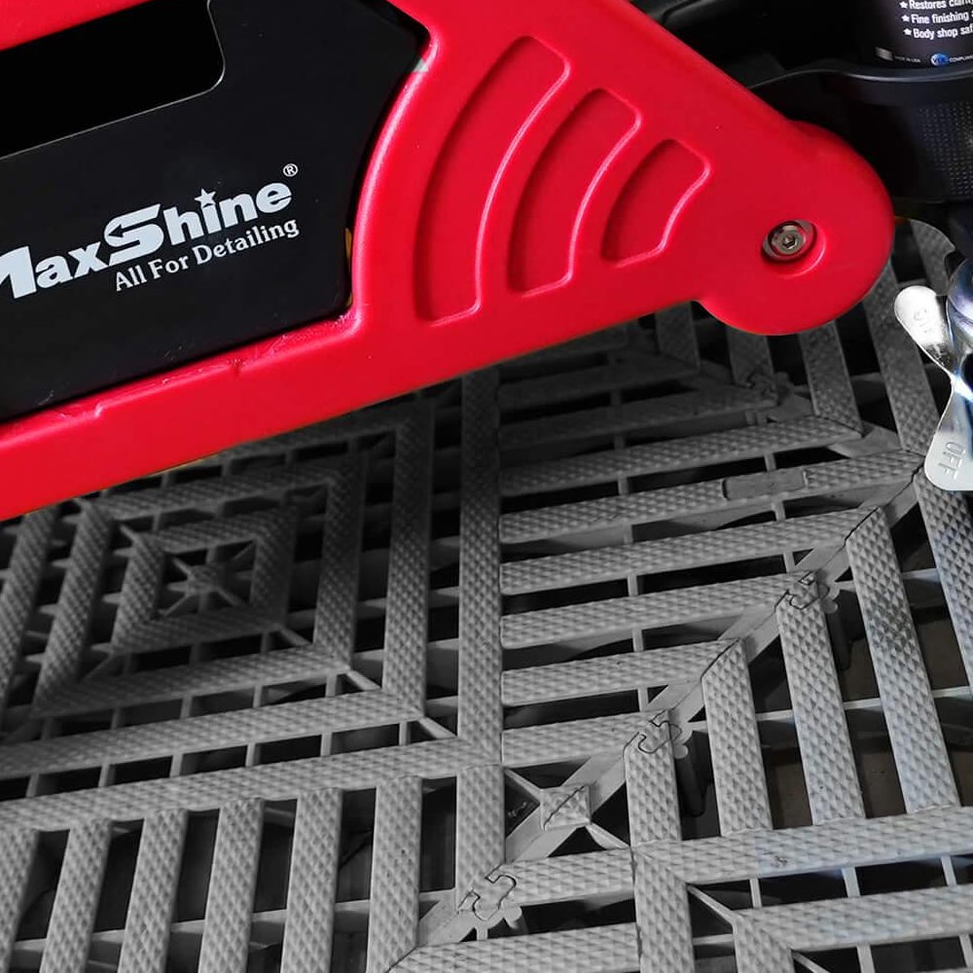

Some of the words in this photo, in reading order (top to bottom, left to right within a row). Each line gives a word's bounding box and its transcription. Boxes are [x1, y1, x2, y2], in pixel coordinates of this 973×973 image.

[909, 0, 947, 9] Restores
[911, 14, 930, 24] Fine
[932, 12, 969, 24] finishing
[913, 28, 935, 40] Body
[937, 28, 958, 38] shop
[115, 265, 148, 292] All
[149, 253, 189, 282] For
[192, 219, 300, 266] Detailing
